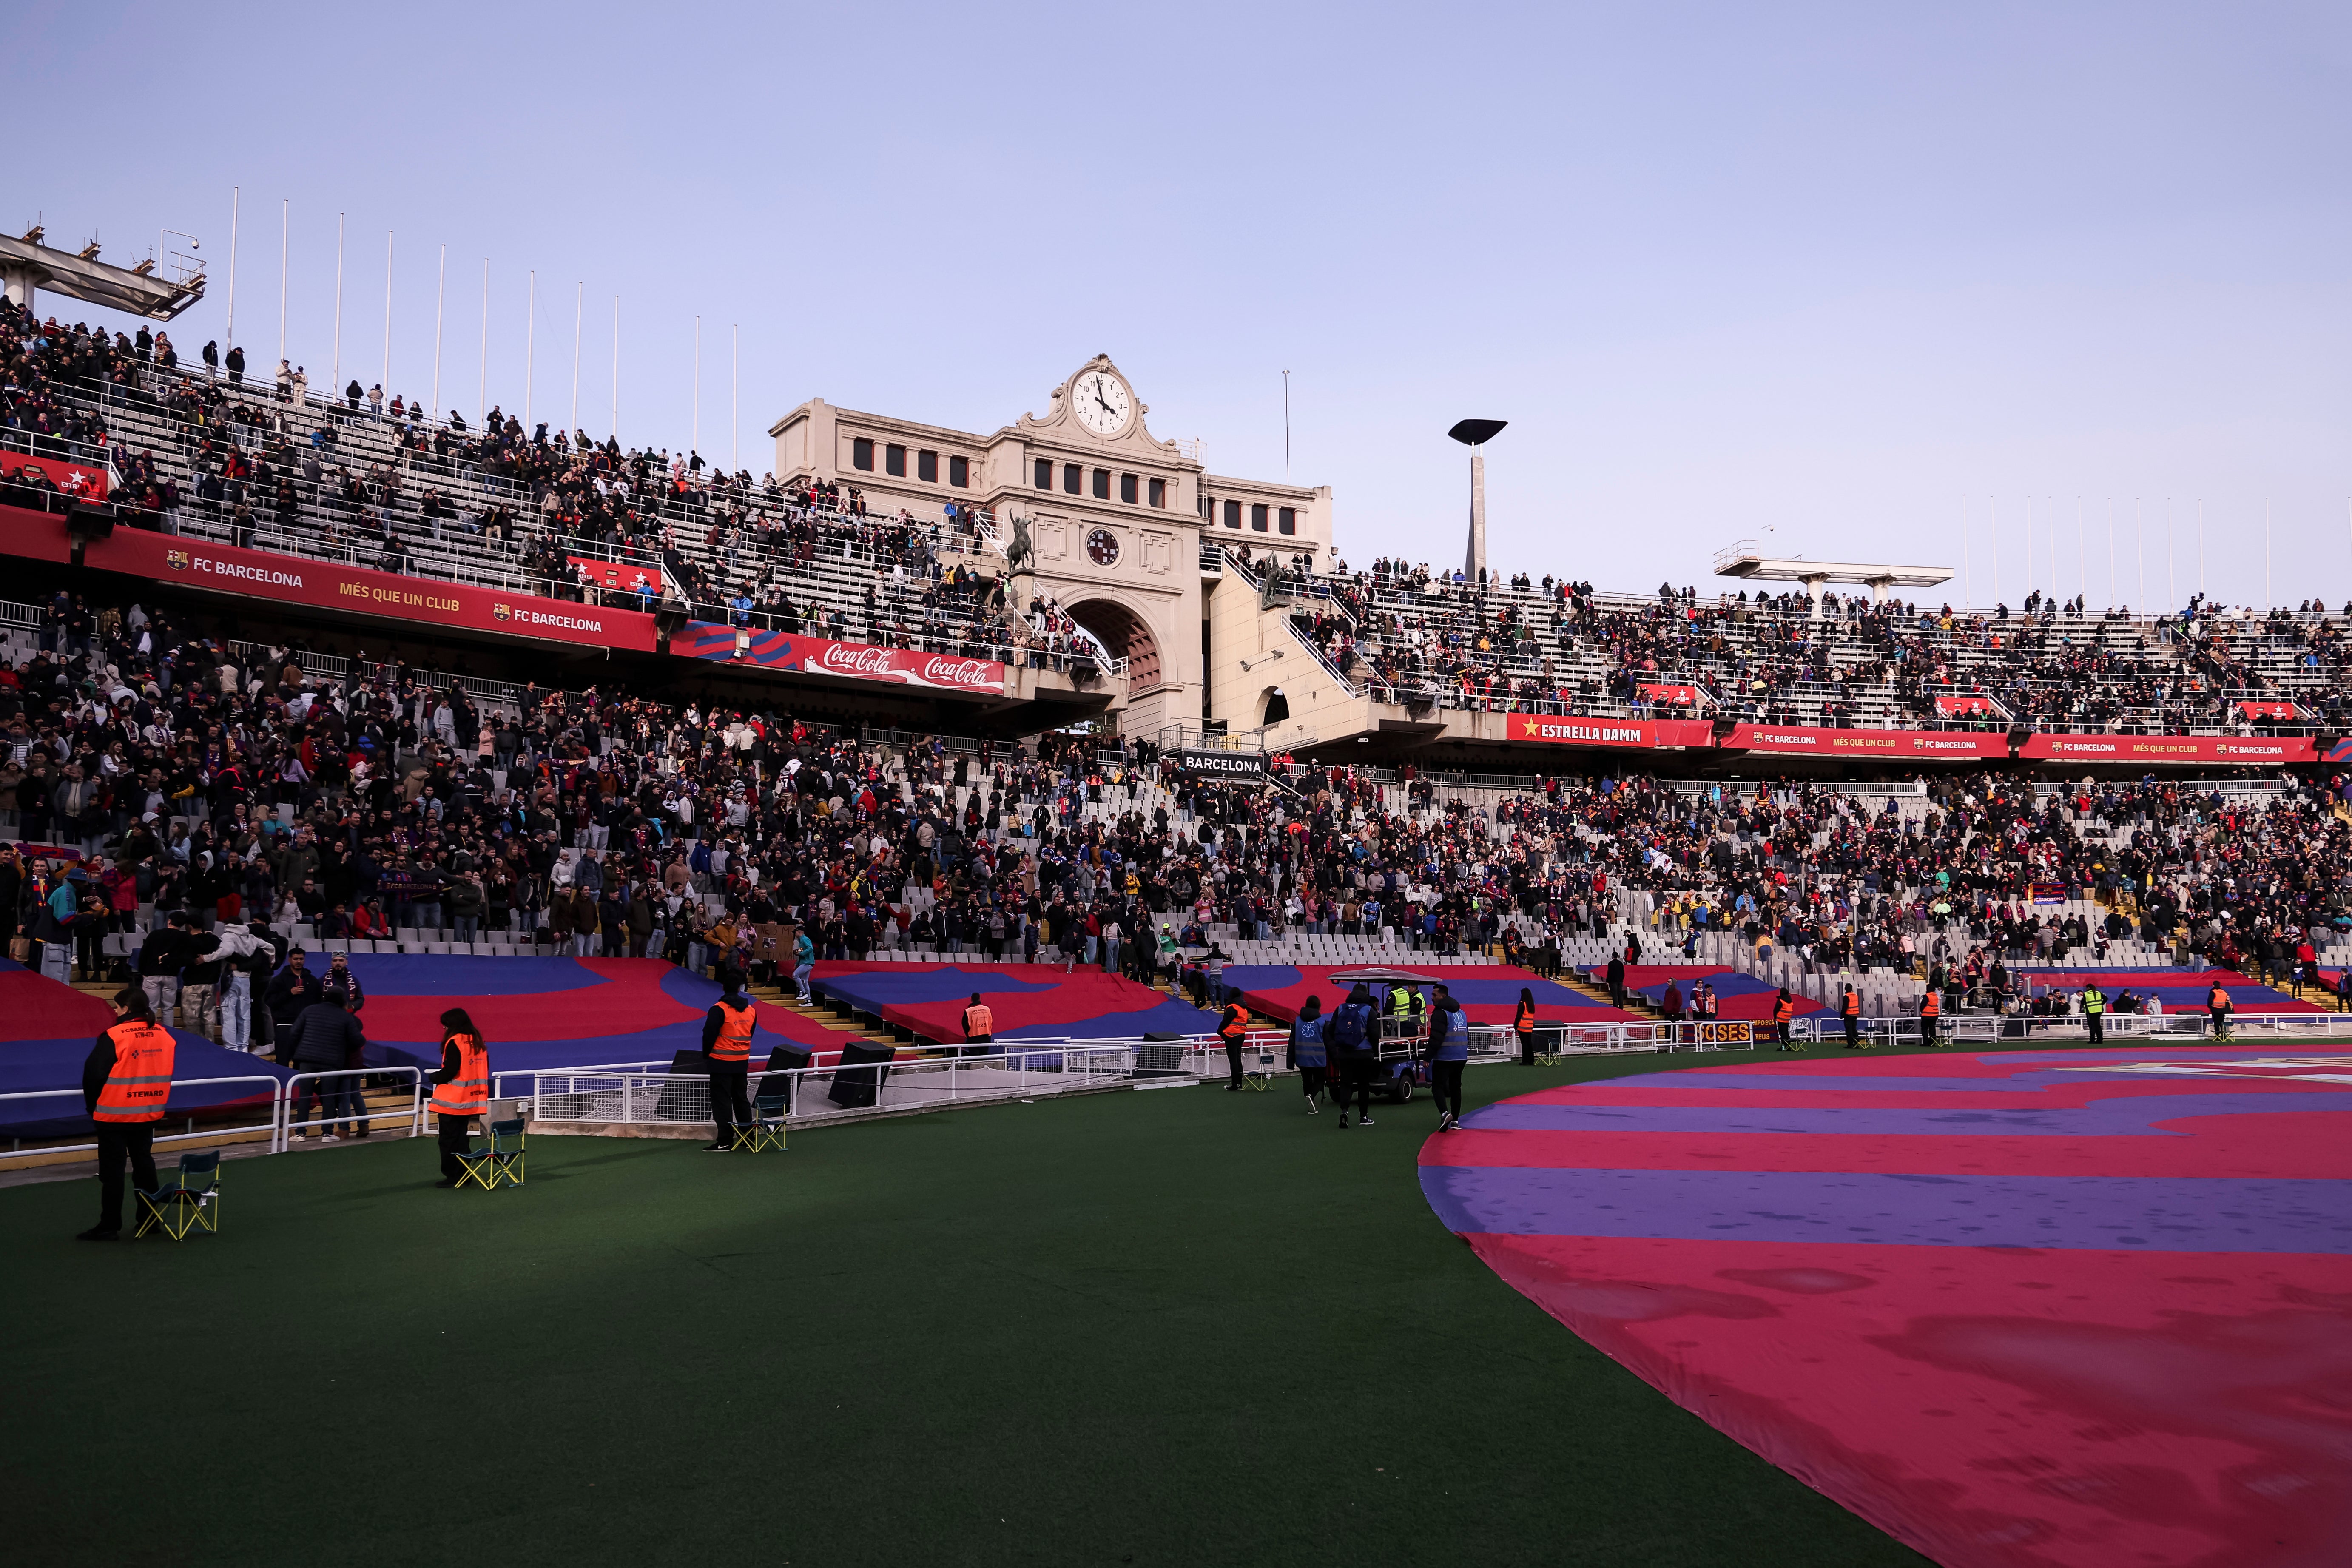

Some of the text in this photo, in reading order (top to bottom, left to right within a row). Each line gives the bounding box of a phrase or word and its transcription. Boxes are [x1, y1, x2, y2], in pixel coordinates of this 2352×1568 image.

[194, 558, 303, 588] FC BARCELONA
[340, 582, 459, 611] MÉS QUE UN CLUB
[515, 610, 602, 633] FC BARCELONA
[824, 643, 894, 672] Coca-Cola
[924, 656, 992, 684] Coca-Cola
[1541, 724, 1641, 742] ESTRELLA DAMM
[1775, 736, 1816, 745] BARCELONA
[1833, 737, 1849, 746] MÉS
[1850, 739, 1864, 747] QUE
[1935, 741, 1977, 749] BARCELONA
[2133, 743, 2149, 752] MÉS
[2150, 746, 2165, 754] QUE
[1186, 757, 1262, 773] BARCELONA
[127, 1090, 164, 1098] STEWARD
